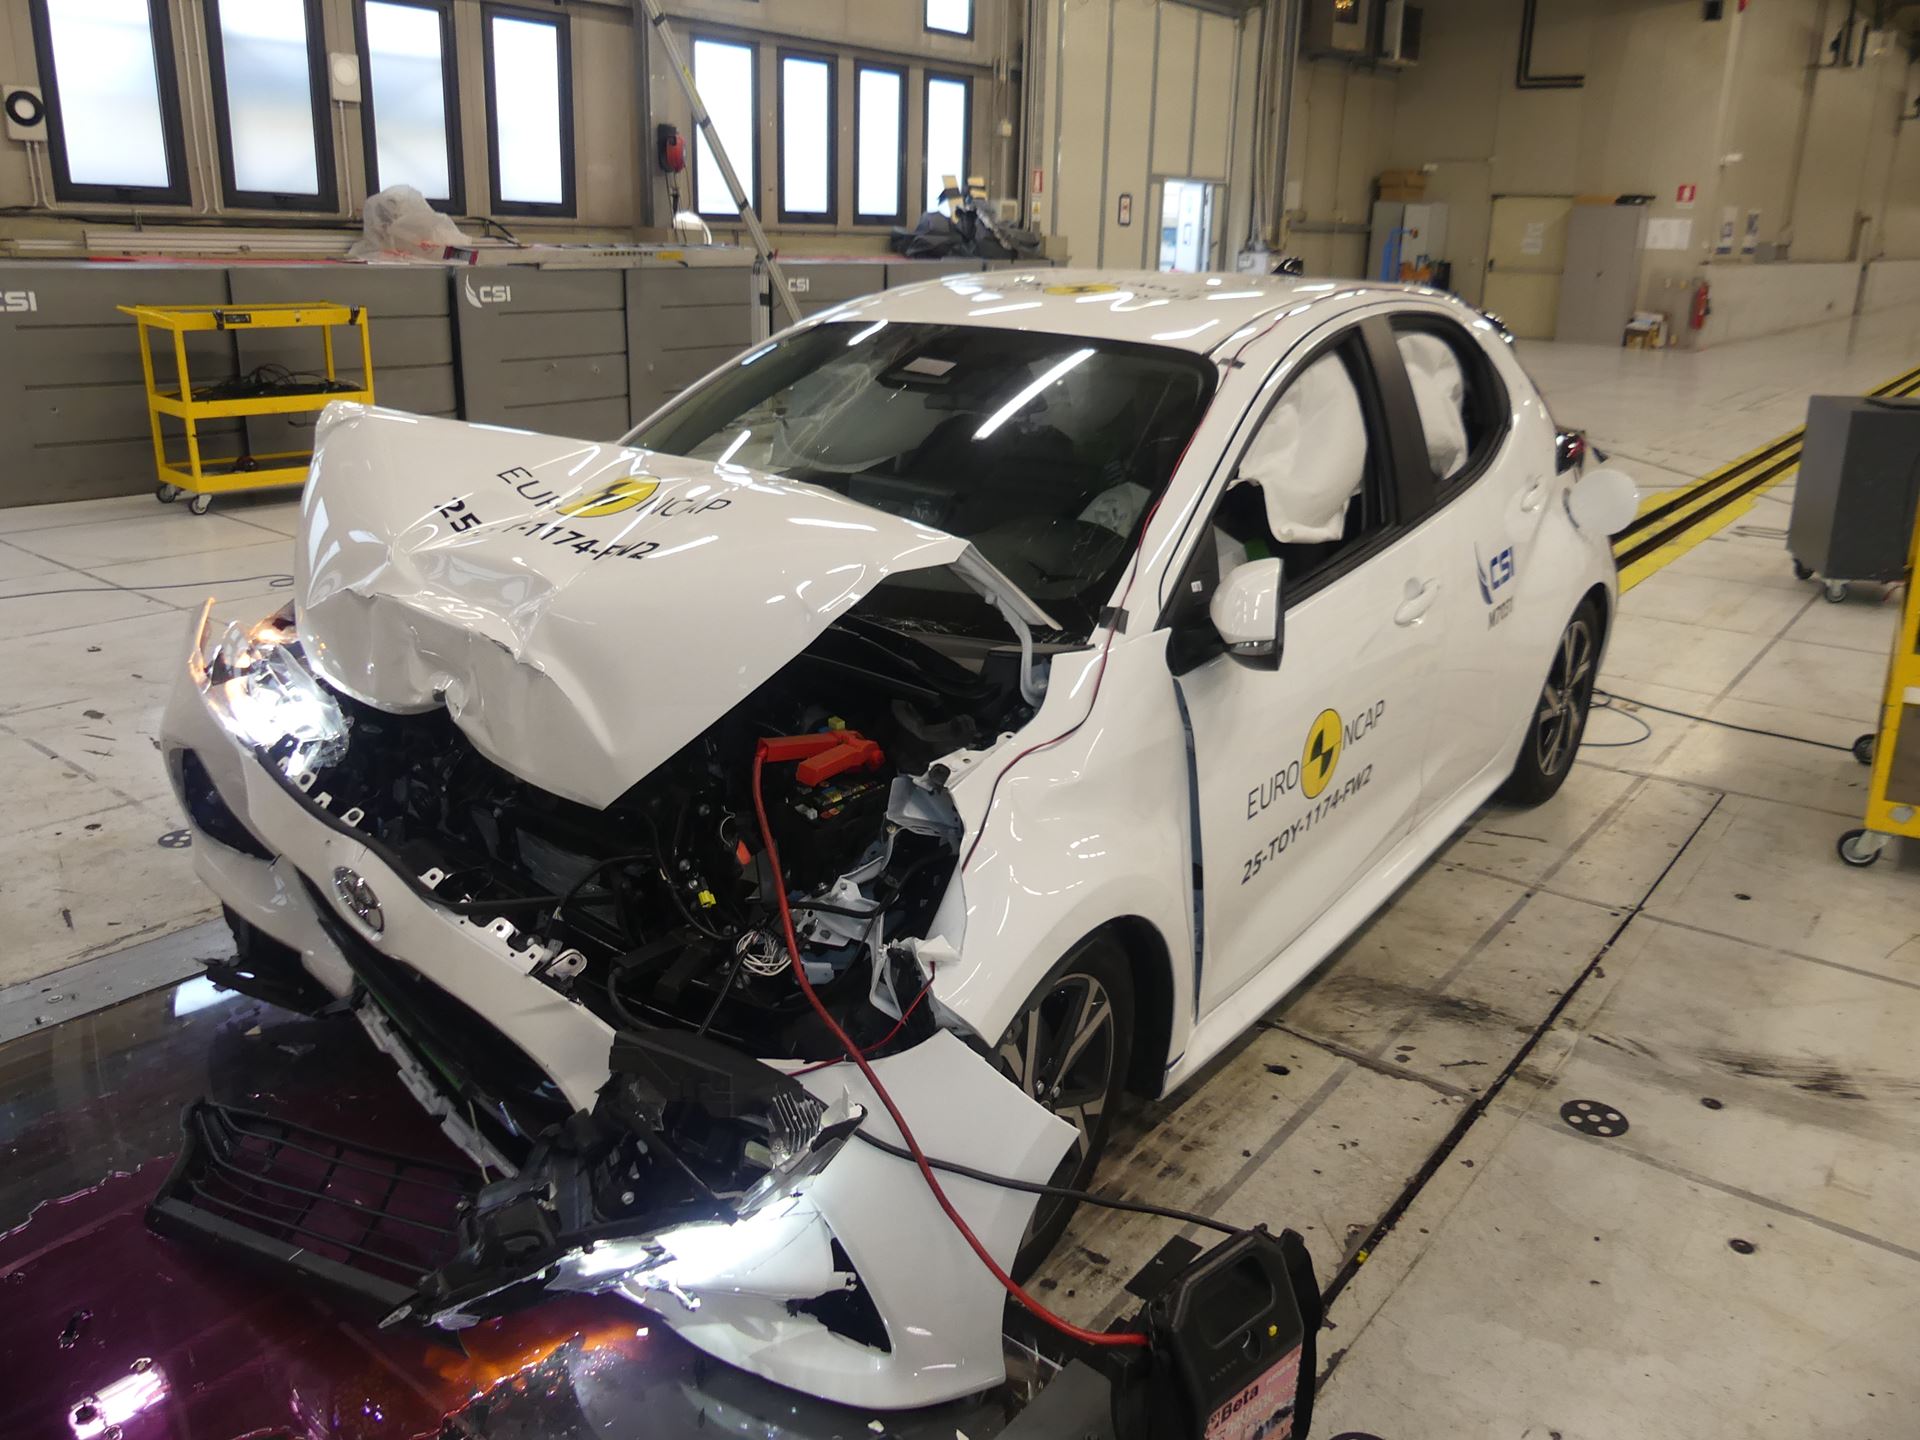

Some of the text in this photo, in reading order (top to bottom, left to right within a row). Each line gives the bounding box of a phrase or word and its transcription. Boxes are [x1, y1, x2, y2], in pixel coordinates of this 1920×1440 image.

[0, 291, 38, 312] SI
[480, 286, 511, 302] CSI
[788, 278, 810, 292] CSI
[496, 466, 564, 511] EU
[434, 496, 660, 561] 25-1174-FW2
[1490, 545, 1514, 590] CSI
[1247, 699, 1385, 821] EURO NCAP
[1240, 763, 1374, 886] 25-TOY-1174-FW2
[1220, 1384, 1260, 1425] Beta
